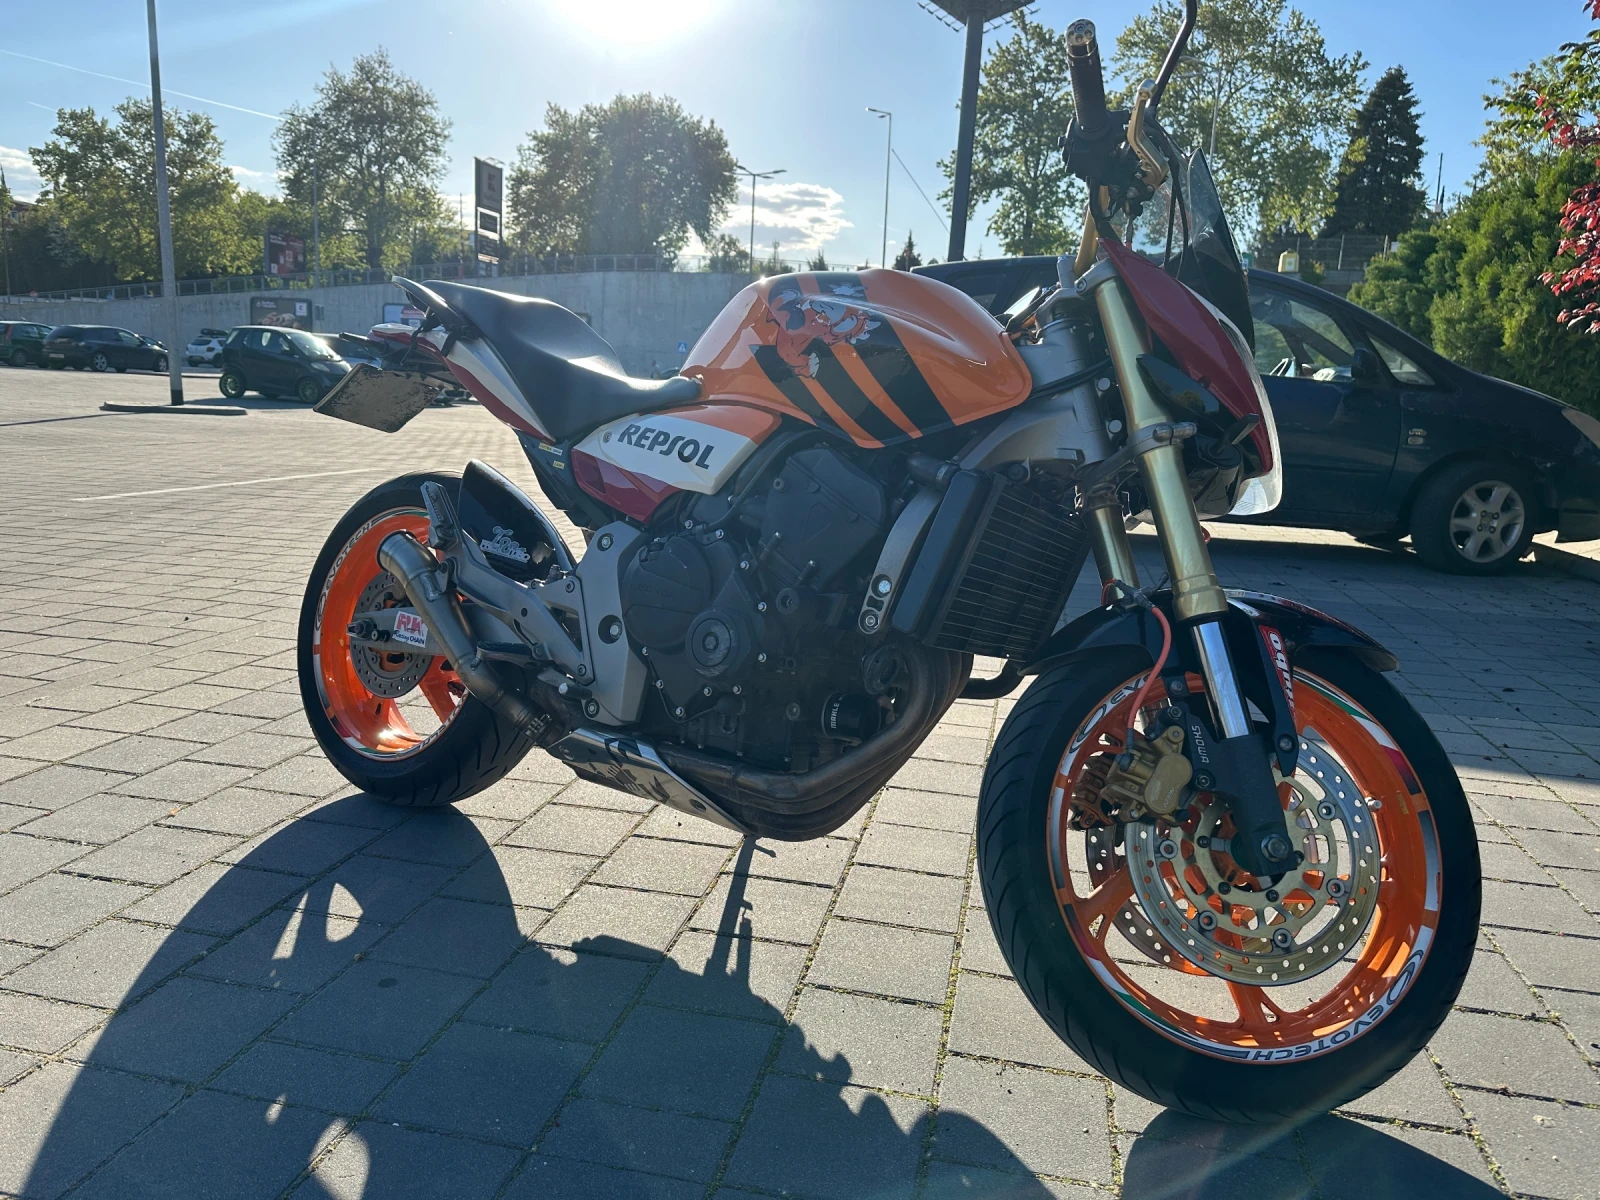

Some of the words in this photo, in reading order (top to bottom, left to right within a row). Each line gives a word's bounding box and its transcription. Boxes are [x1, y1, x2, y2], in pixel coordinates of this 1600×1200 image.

[617, 423, 715, 470] REPSOL
[325, 522, 374, 592] EVOTECH
[410, 635, 425, 645] CHAIN
[1191, 725, 1210, 763] SHOWA
[1251, 1004, 1384, 1061] EVOTECH
